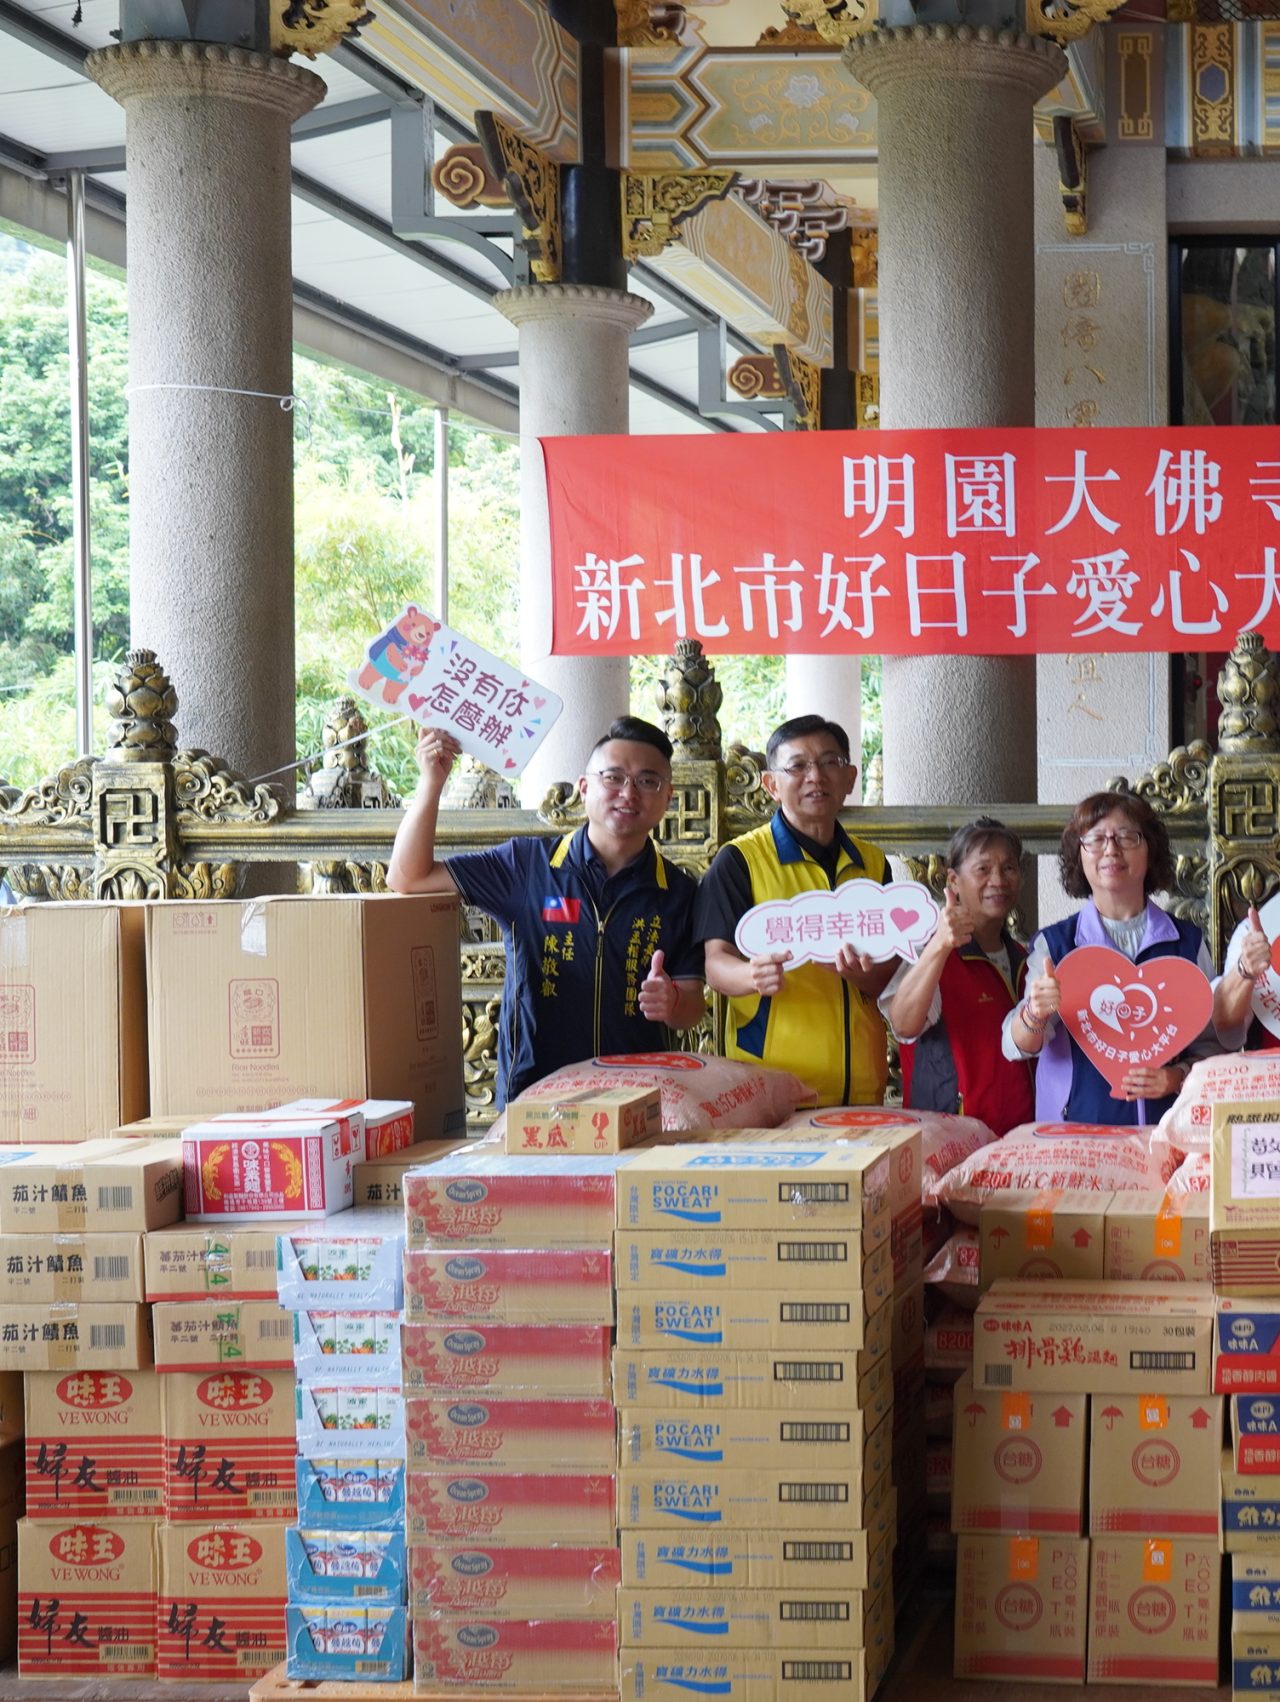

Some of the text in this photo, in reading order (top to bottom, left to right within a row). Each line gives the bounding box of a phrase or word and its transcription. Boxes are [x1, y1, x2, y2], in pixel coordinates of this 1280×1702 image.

[443, 652, 530, 717] 沒有你
[425, 682, 513, 748] 怎麼辦
[764, 909, 886, 945] 覺得幸福
[562, 930, 576, 961] 主任
[1075, 1007, 1179, 1063] 新北市好日子愛心大平台
[521, 1122, 568, 1149] 黑瓜
[12, 1183, 89, 1203] 茄汁鯖魚
[652, 1185, 719, 1197] POCARI
[652, 1196, 713, 1208] SWEAT
[650, 1248, 722, 1260] 寶礦力水得
[6, 1254, 84, 1274] 茄汁鯖魚
[655, 1305, 721, 1317] POCARI
[2, 1322, 80, 1341] 茄汁鯖魚
[655, 1317, 714, 1329] SWEAT
[648, 1366, 719, 1379] 寶礦力水得
[66, 1374, 125, 1407] 味王
[206, 1374, 265, 1407] 味王
[655, 1423, 721, 1435] POCARI
[655, 1435, 714, 1447] SWEAT
[1003, 1451, 1035, 1468] 台糖
[1141, 1454, 1171, 1471] 台糖
[106, 1470, 139, 1486] 醬油
[245, 1472, 278, 1488] 醬油
[653, 1484, 719, 1496] POCARI
[653, 1496, 713, 1508] SWEAT
[58, 1530, 117, 1563] 味王
[196, 1535, 254, 1568] 味王
[656, 1545, 728, 1557] 寶礦力水得
[652, 1605, 725, 1617] 寶礦力水得
[1003, 1597, 1034, 1614] 台糖
[1136, 1600, 1167, 1617] 台糖
[97, 1626, 130, 1643] 醬油
[235, 1631, 268, 1648] 醬油
[655, 1666, 728, 1678] 寶礦力水得
